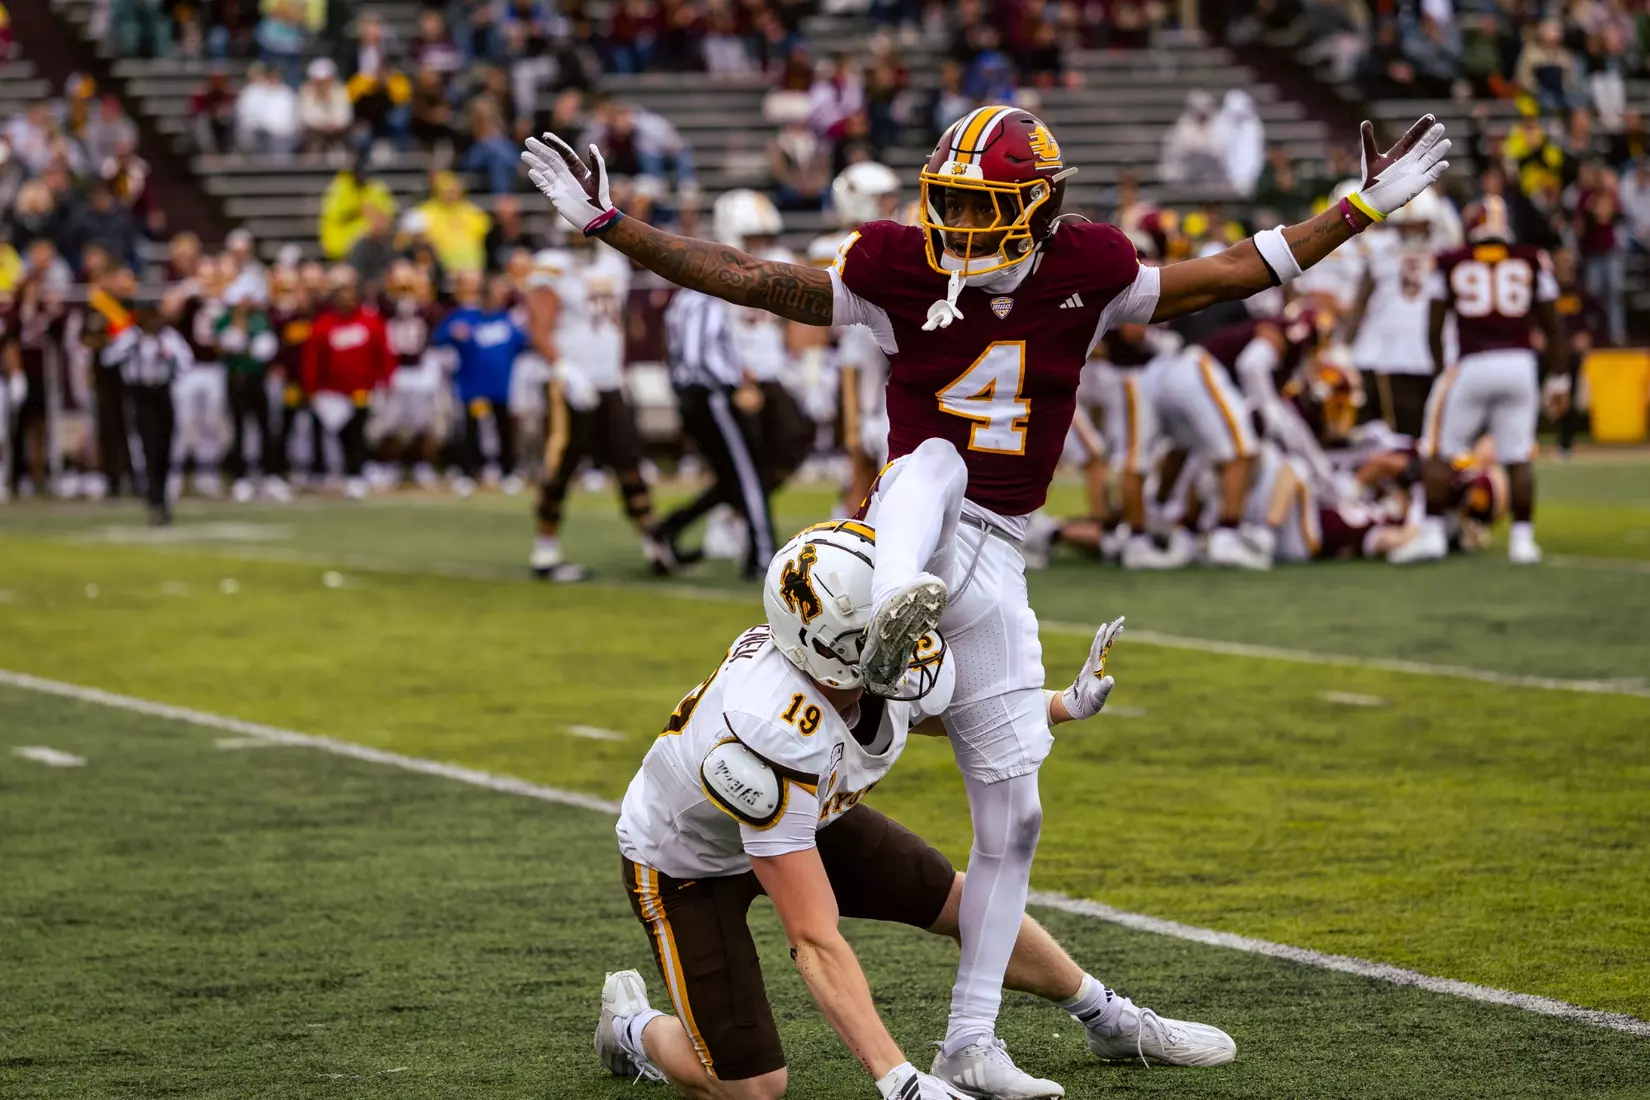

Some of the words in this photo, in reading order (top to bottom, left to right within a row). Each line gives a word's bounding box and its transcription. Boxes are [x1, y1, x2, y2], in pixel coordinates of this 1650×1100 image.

[1451, 257, 1532, 318] 96
[935, 340, 1031, 456] 4
[780, 691, 823, 737] 19
